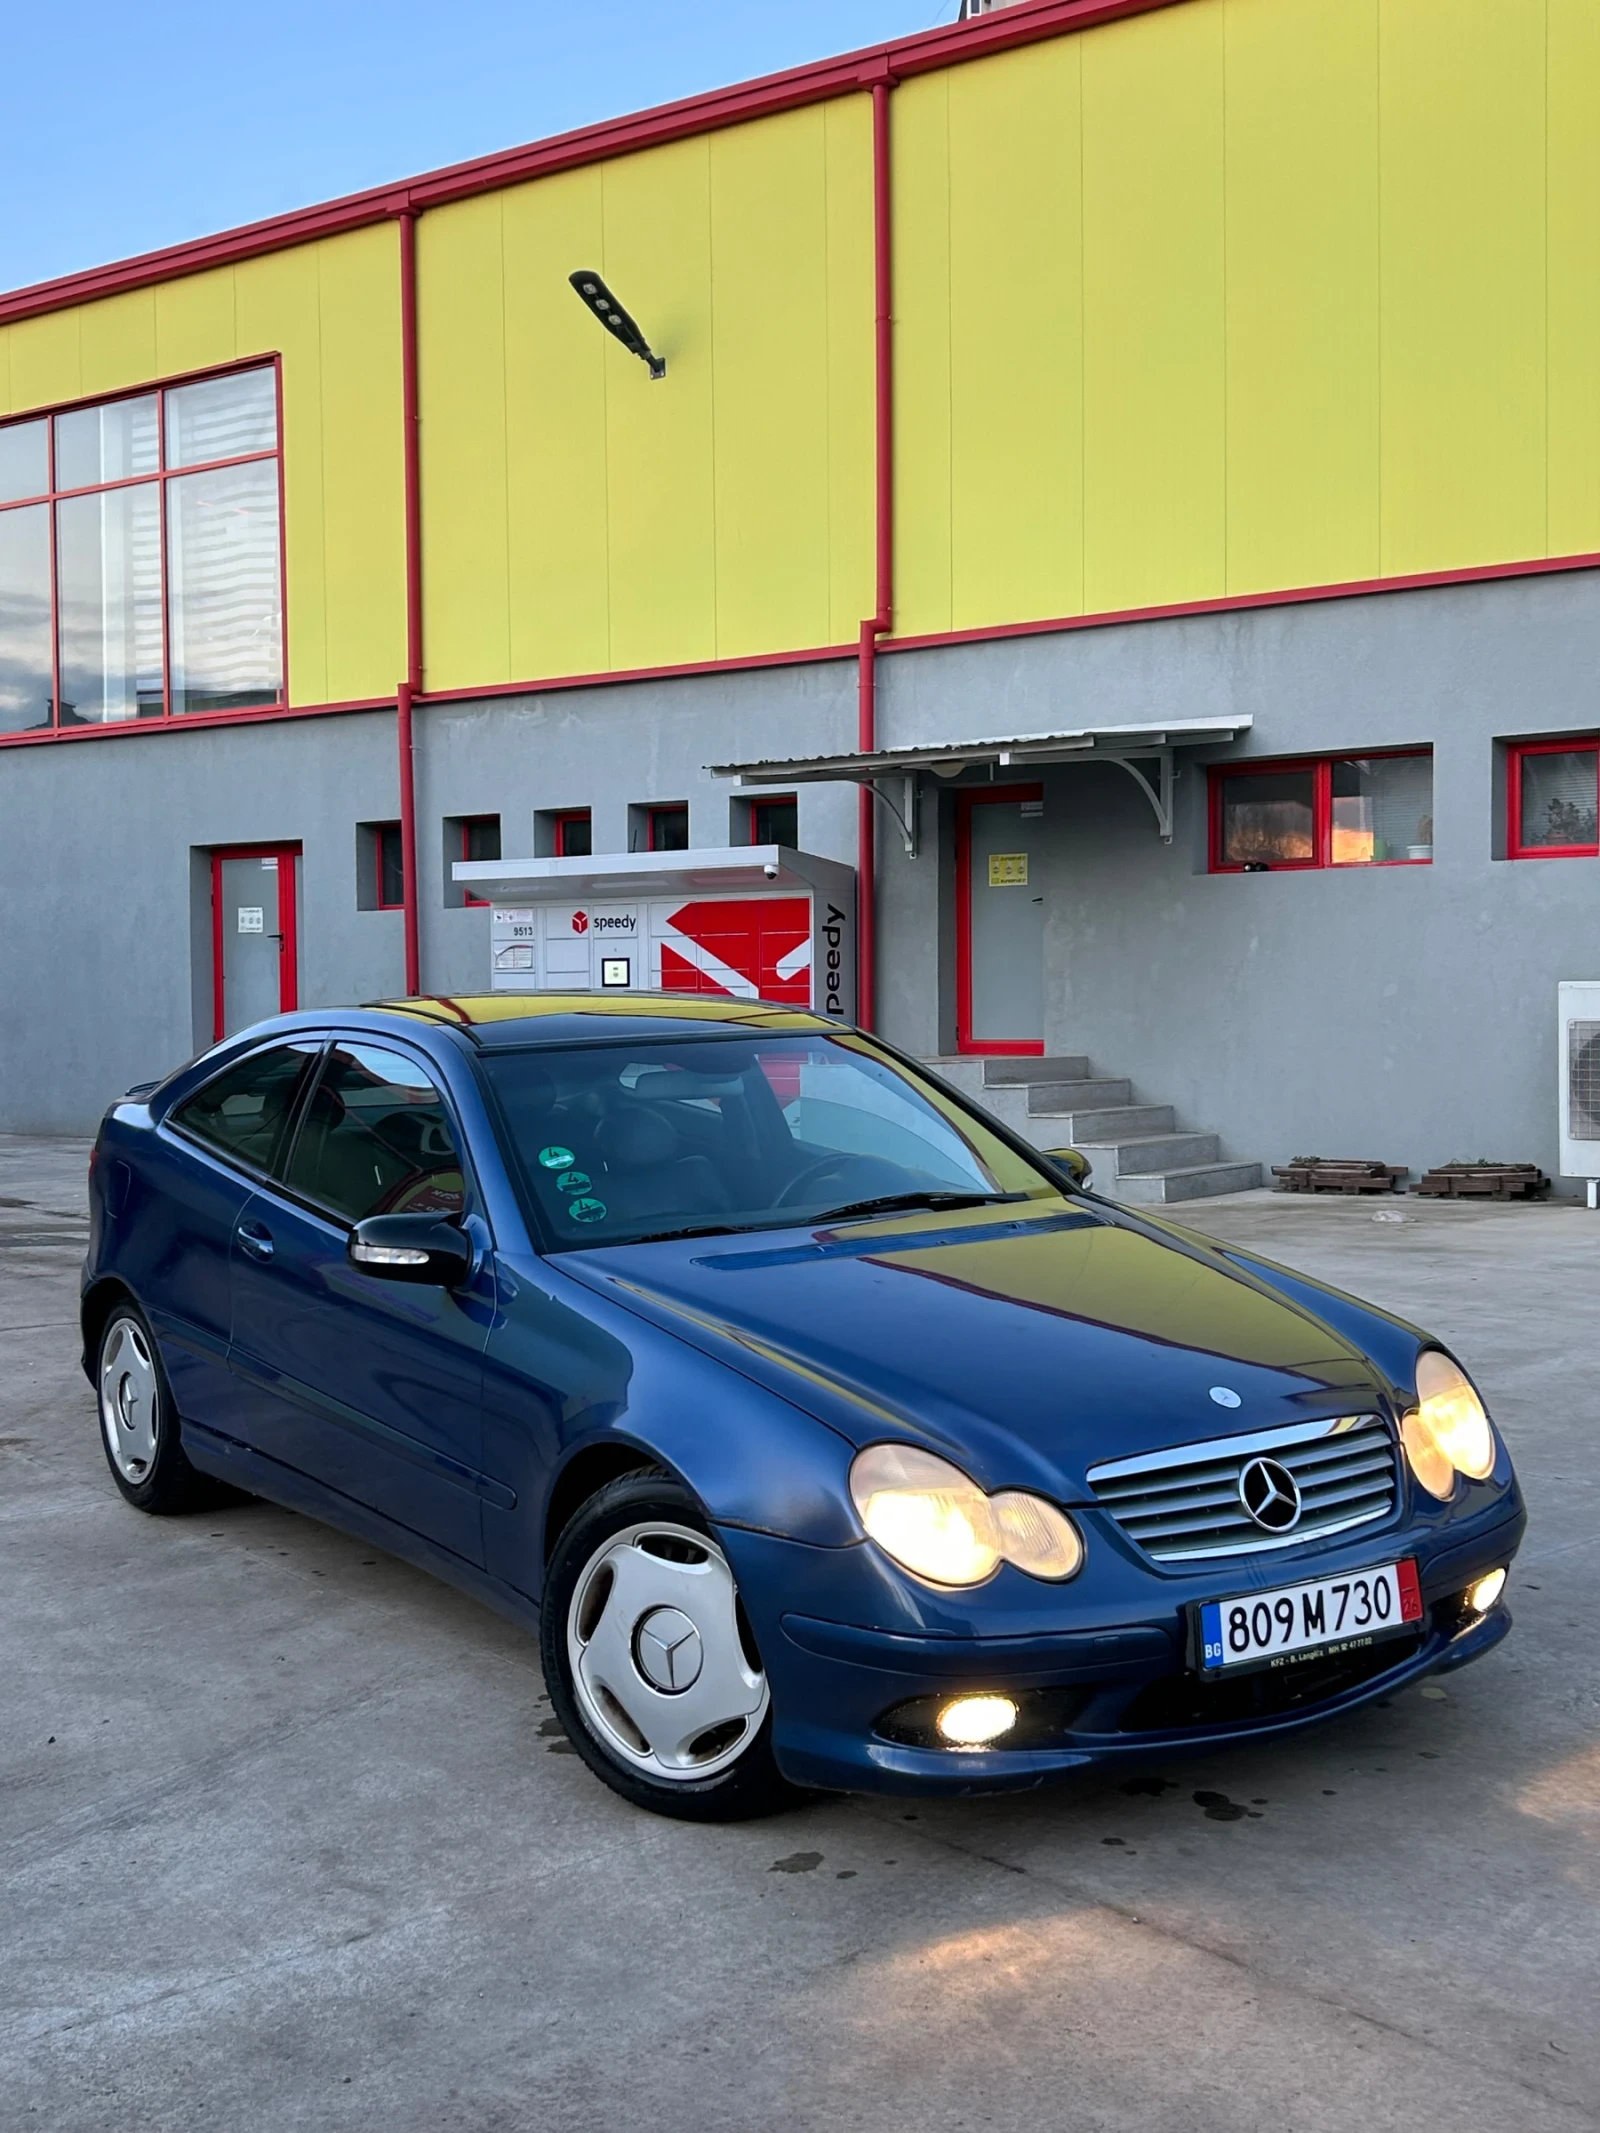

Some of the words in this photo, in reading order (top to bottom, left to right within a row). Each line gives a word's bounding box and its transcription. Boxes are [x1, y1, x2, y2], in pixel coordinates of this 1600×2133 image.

[513, 926, 533, 936] 9513
[593, 914, 636, 931] speedy
[821, 903, 846, 1015] peedy
[1204, 1642, 1222, 1659] BG
